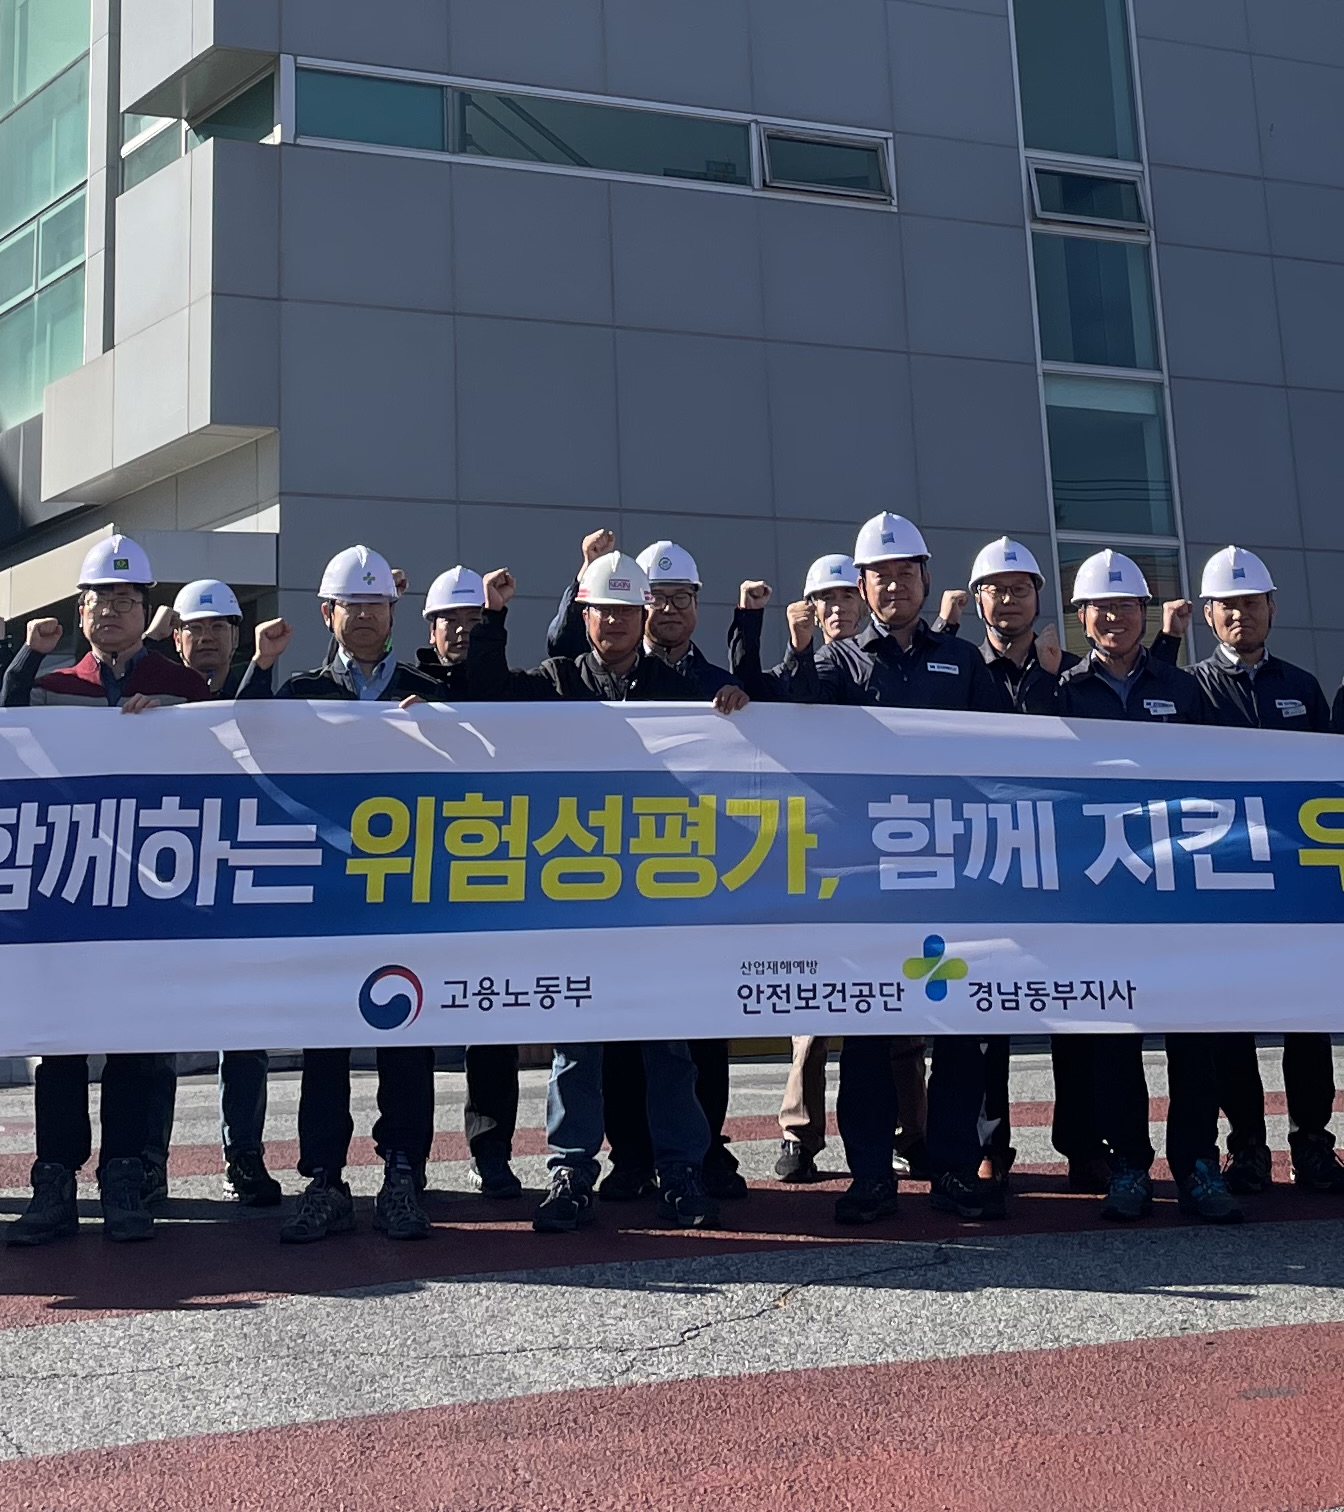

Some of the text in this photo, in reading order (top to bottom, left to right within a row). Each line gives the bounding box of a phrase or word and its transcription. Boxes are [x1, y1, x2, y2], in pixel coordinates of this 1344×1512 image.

[344, 792, 841, 903] 위험성평가,
[867, 794, 1059, 891] 함께
[1082, 796, 1277, 893] 지킨
[739, 958, 819, 976] 산업재해예방
[440, 975, 593, 1012] 고용노동부
[736, 979, 1137, 1015] 안전보건공단 경남동부지사
